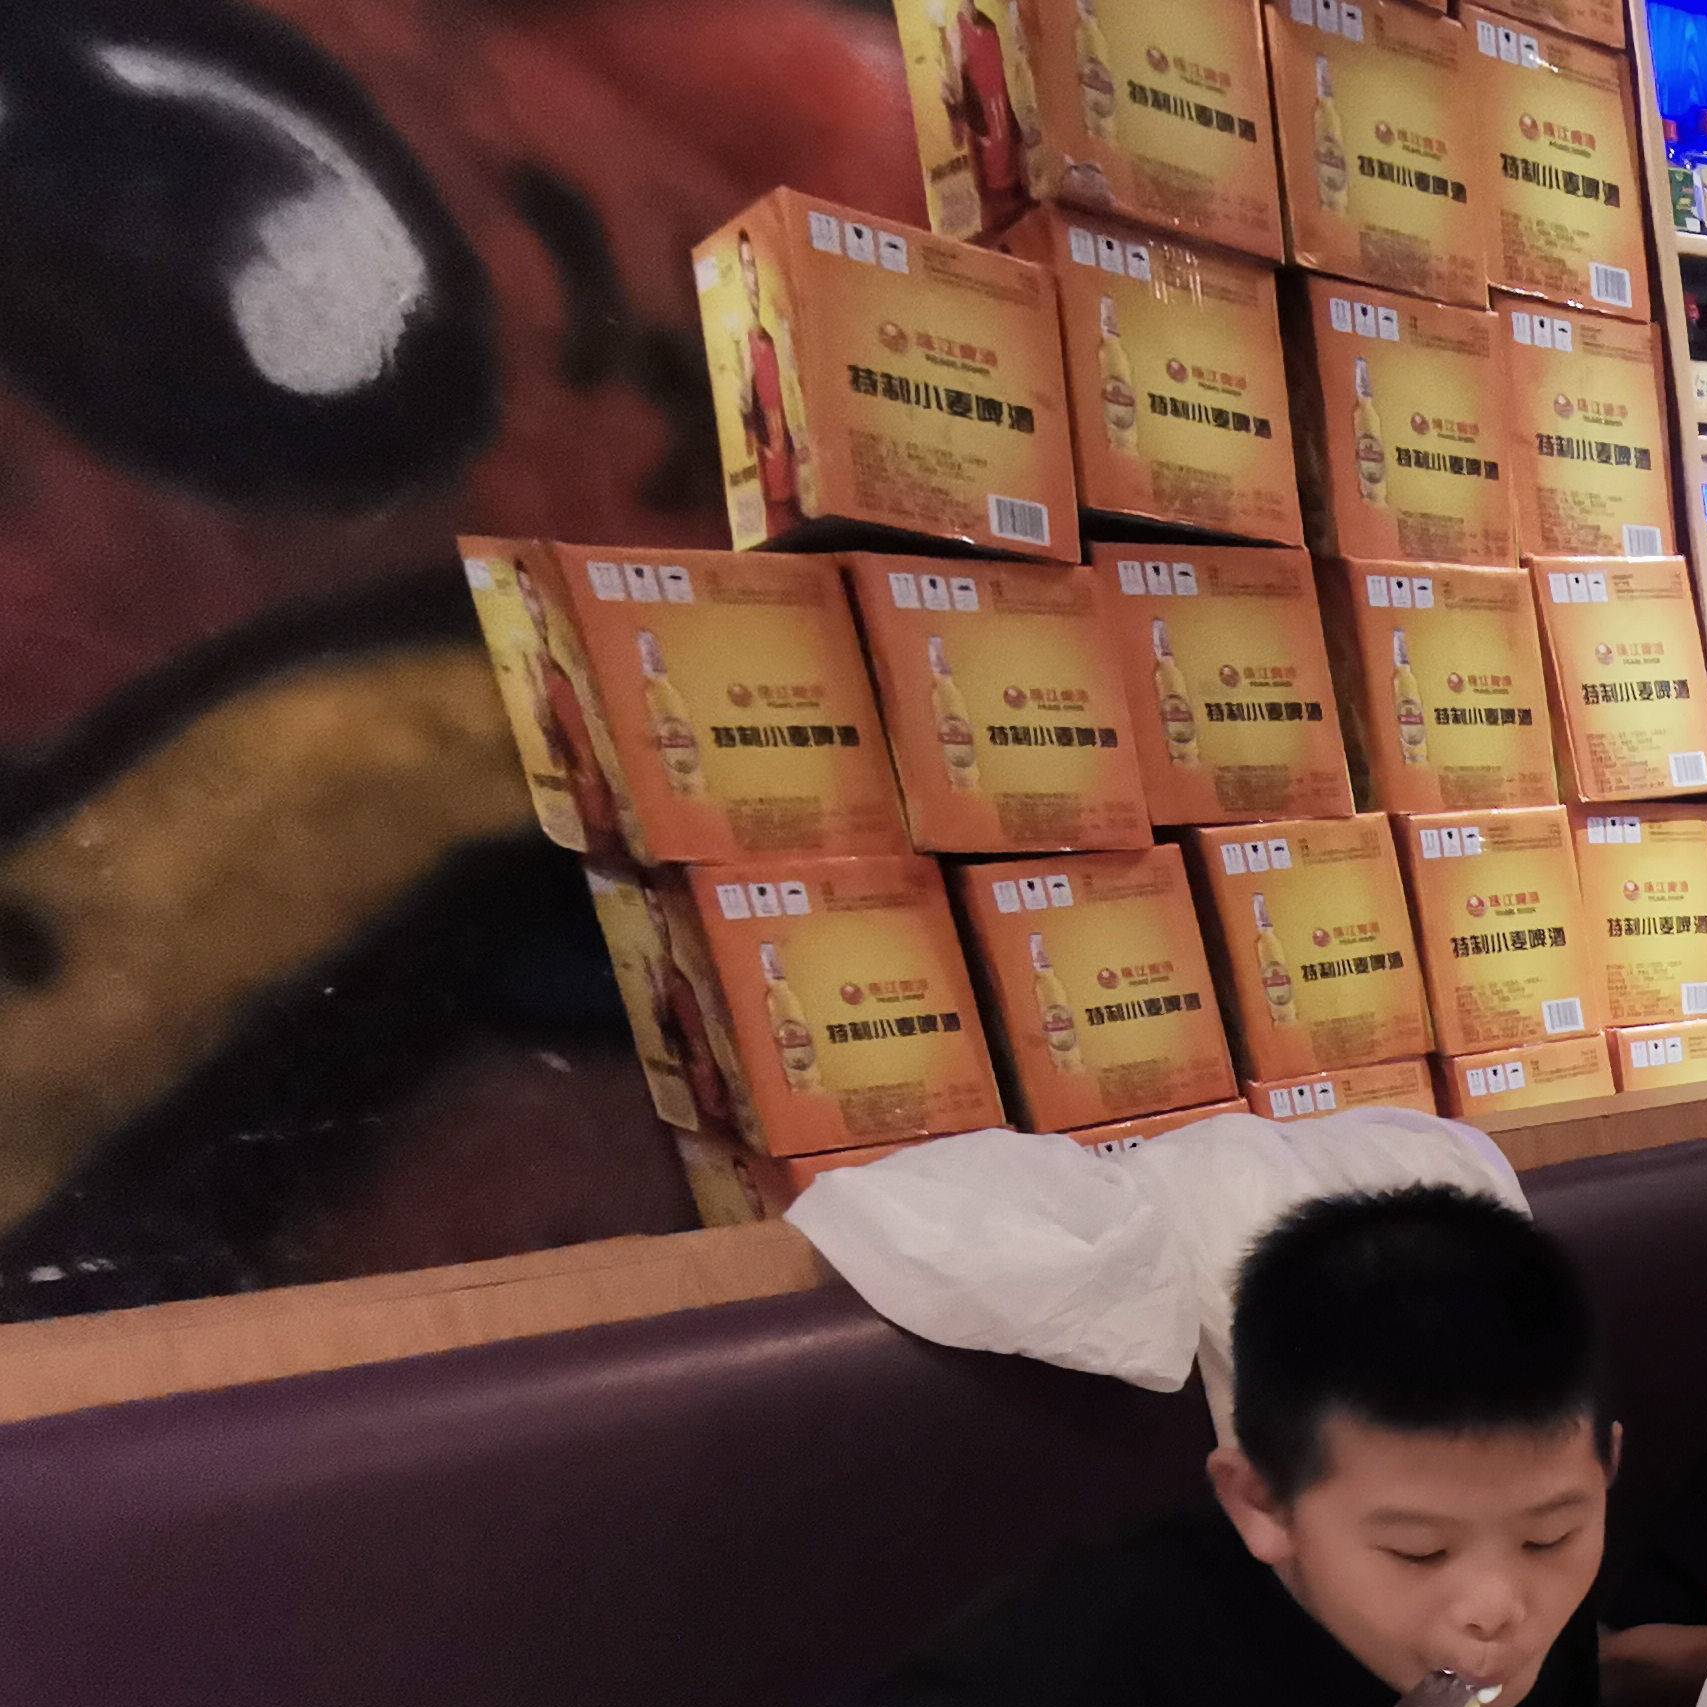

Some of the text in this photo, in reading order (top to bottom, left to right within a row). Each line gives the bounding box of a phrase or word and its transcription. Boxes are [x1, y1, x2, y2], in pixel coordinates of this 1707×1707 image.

[1582, 679, 1690, 705] 特制小麦啤酒
[1607, 915, 1707, 937] 特制小麦啤酒
[1450, 927, 1566, 959] 特制小麦啤酒
